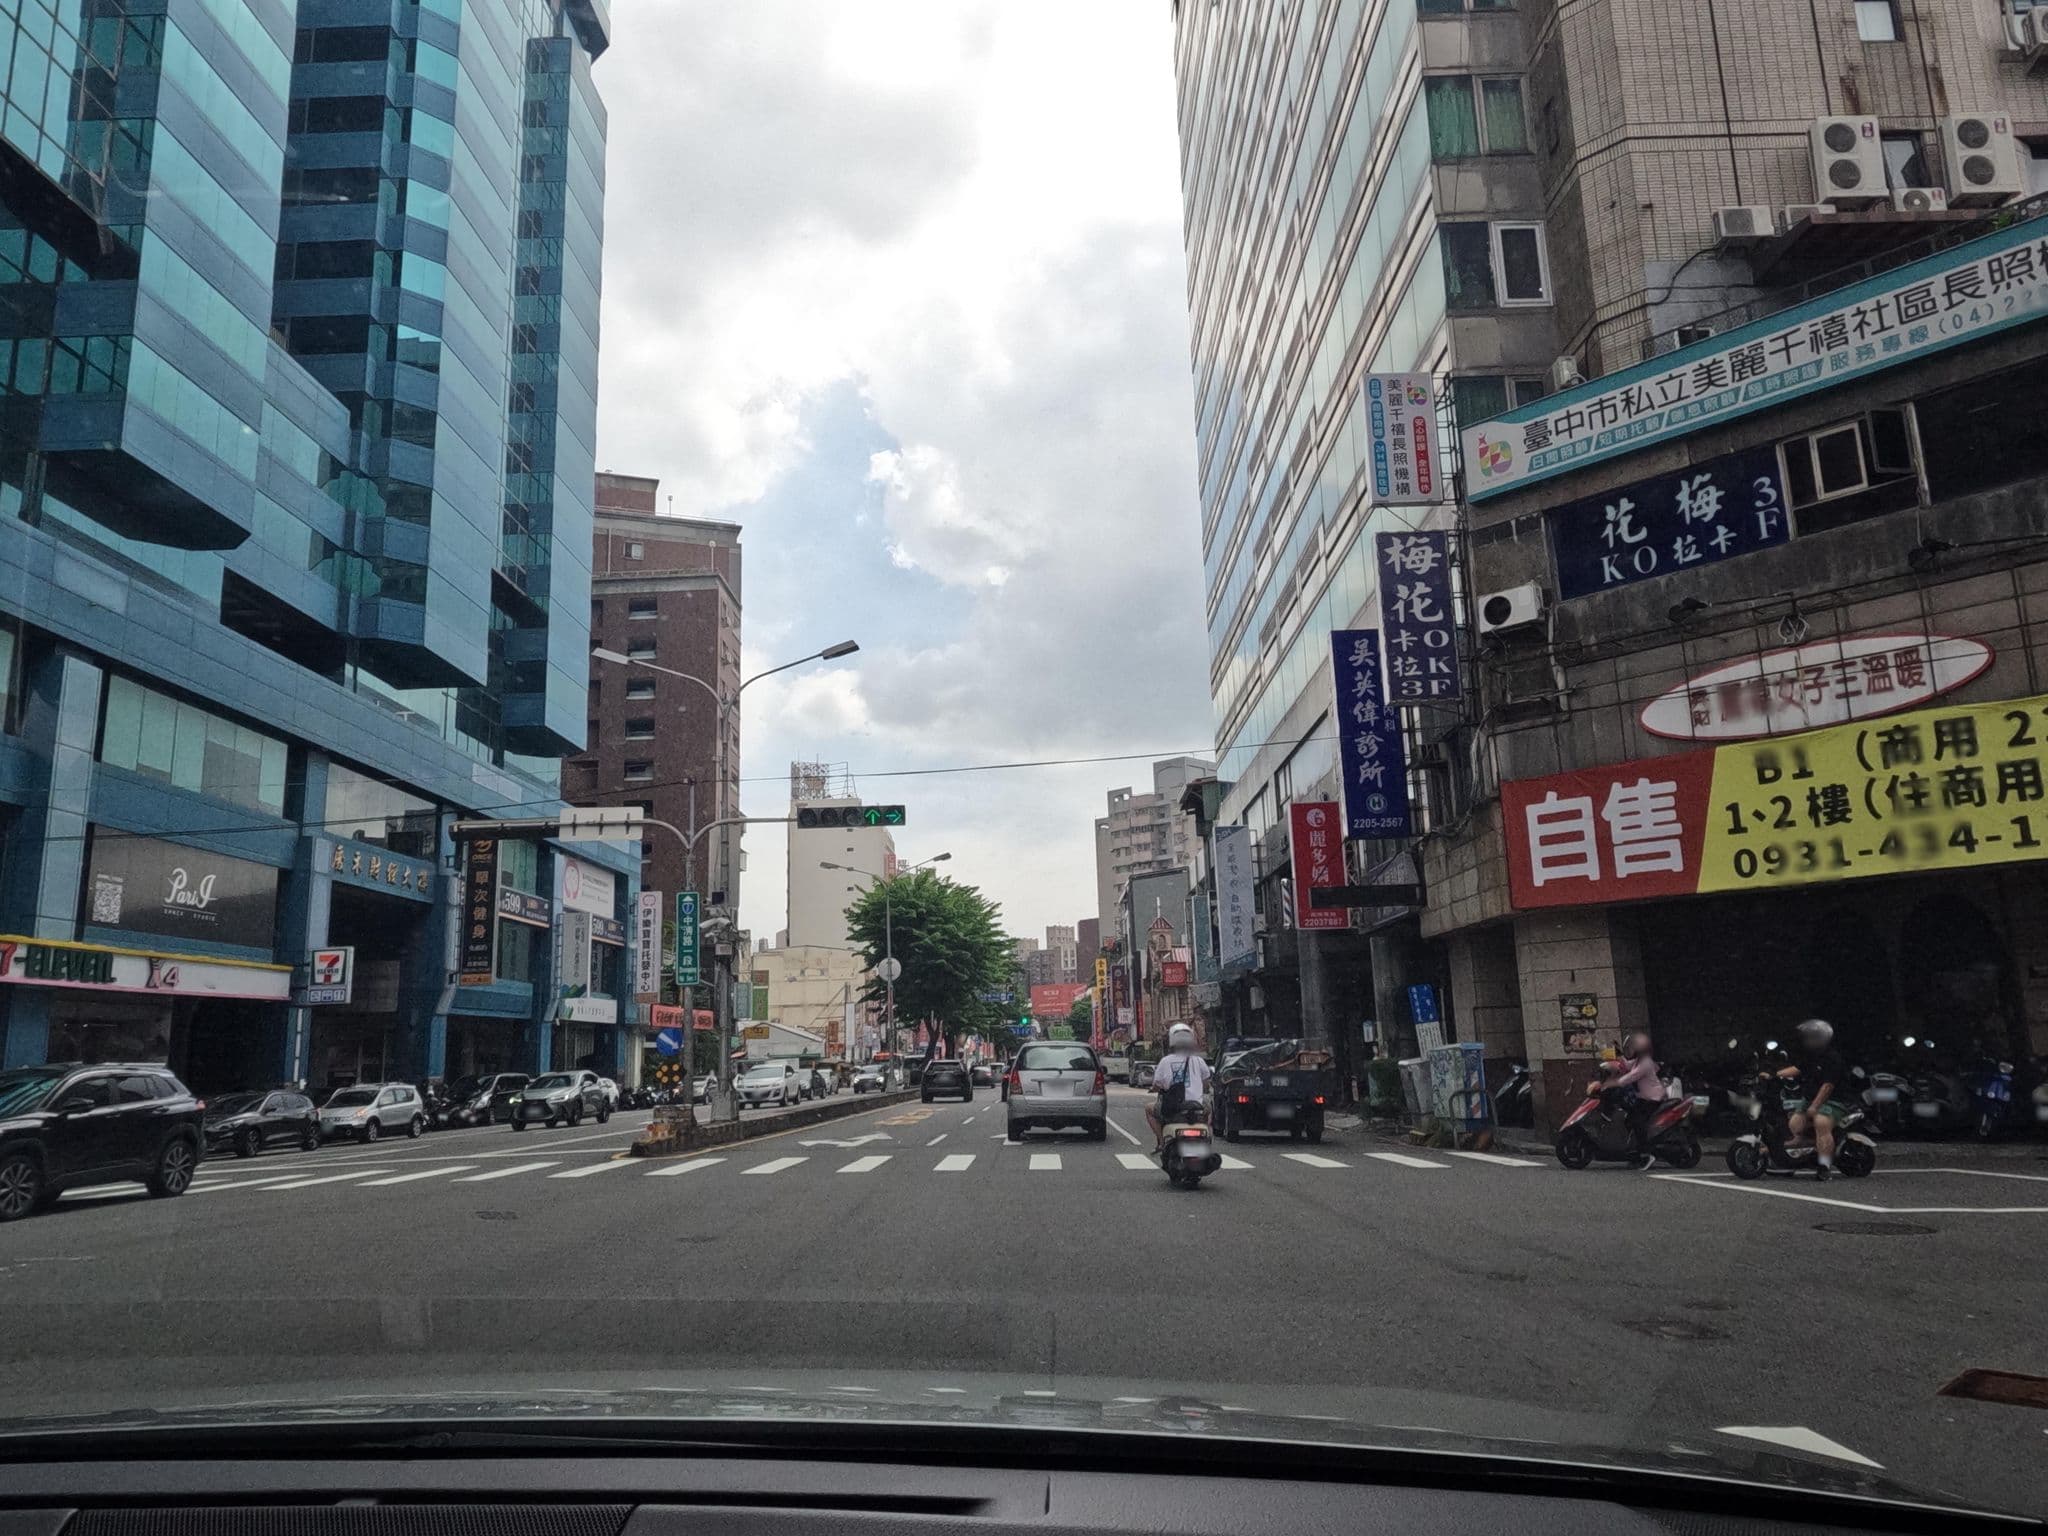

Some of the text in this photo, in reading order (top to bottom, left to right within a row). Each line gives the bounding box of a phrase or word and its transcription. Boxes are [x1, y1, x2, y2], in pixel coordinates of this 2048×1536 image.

[1387, 379, 1411, 496] 美麗千禧長照機構
[1385, 535, 1445, 624] 梅花
[1348, 638, 1386, 789] 吳英偉診所
[1400, 678, 1452, 698] 3F
[1352, 816, 1405, 830] 2205-2567
[1525, 777, 1685, 888] 自售
[504, 891, 521, 914] 599
